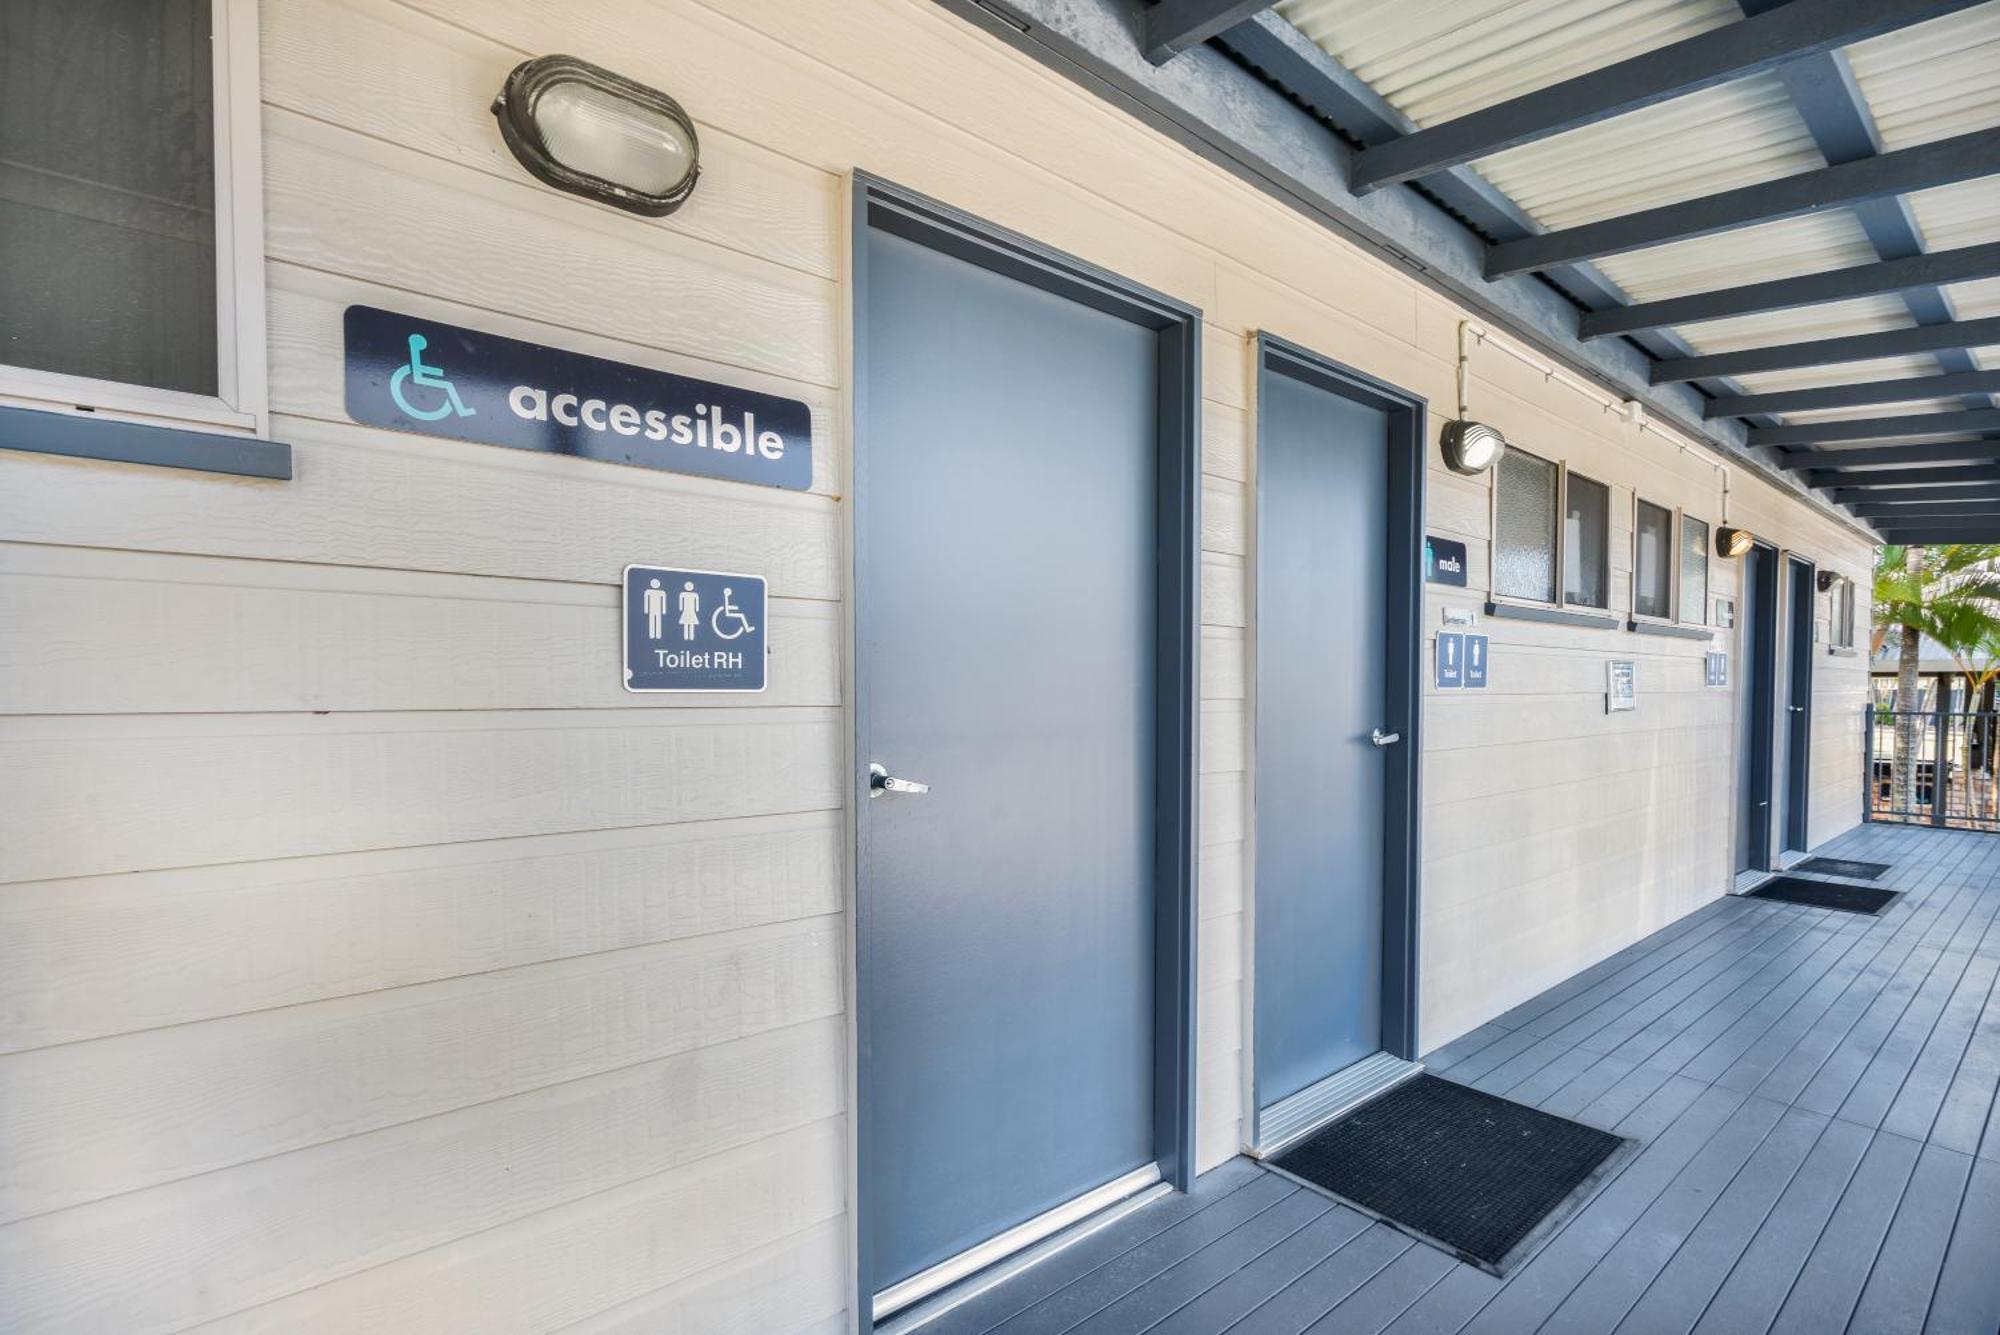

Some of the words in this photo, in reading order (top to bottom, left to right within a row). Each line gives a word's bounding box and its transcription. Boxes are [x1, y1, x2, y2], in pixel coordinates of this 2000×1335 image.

[508, 385, 785, 460] accessible
[1439, 556, 1460, 573] male
[654, 649, 710, 669] Toilet
[713, 651, 742, 669] RH
